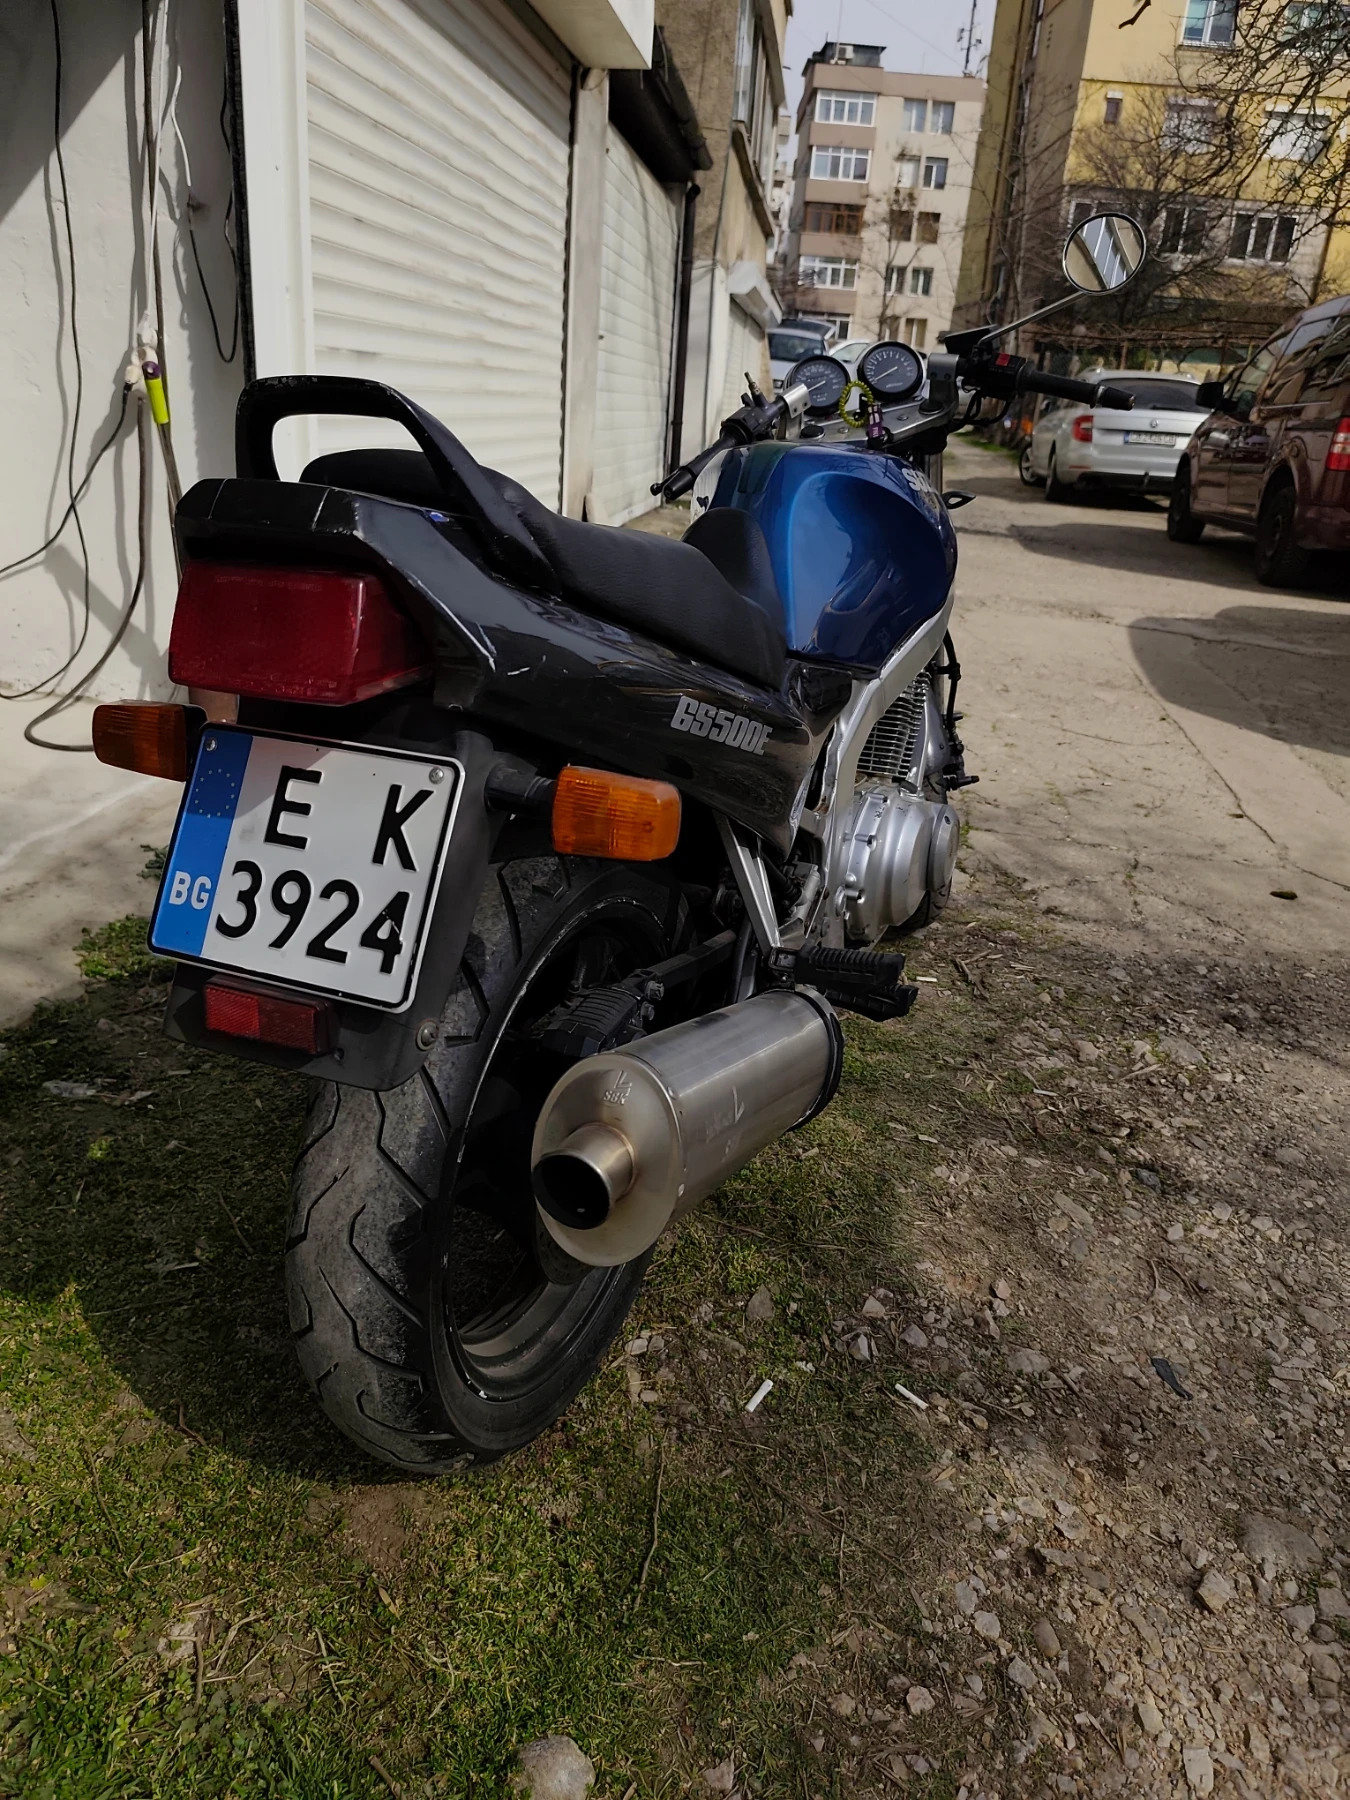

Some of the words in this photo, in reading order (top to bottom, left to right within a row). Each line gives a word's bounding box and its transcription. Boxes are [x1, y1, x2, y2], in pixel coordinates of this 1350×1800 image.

[670, 695, 774, 756] GS500E
[263, 765, 323, 850] E
[372, 784, 434, 872] K
[168, 871, 213, 910] BG
[215, 860, 411, 975] 3924
